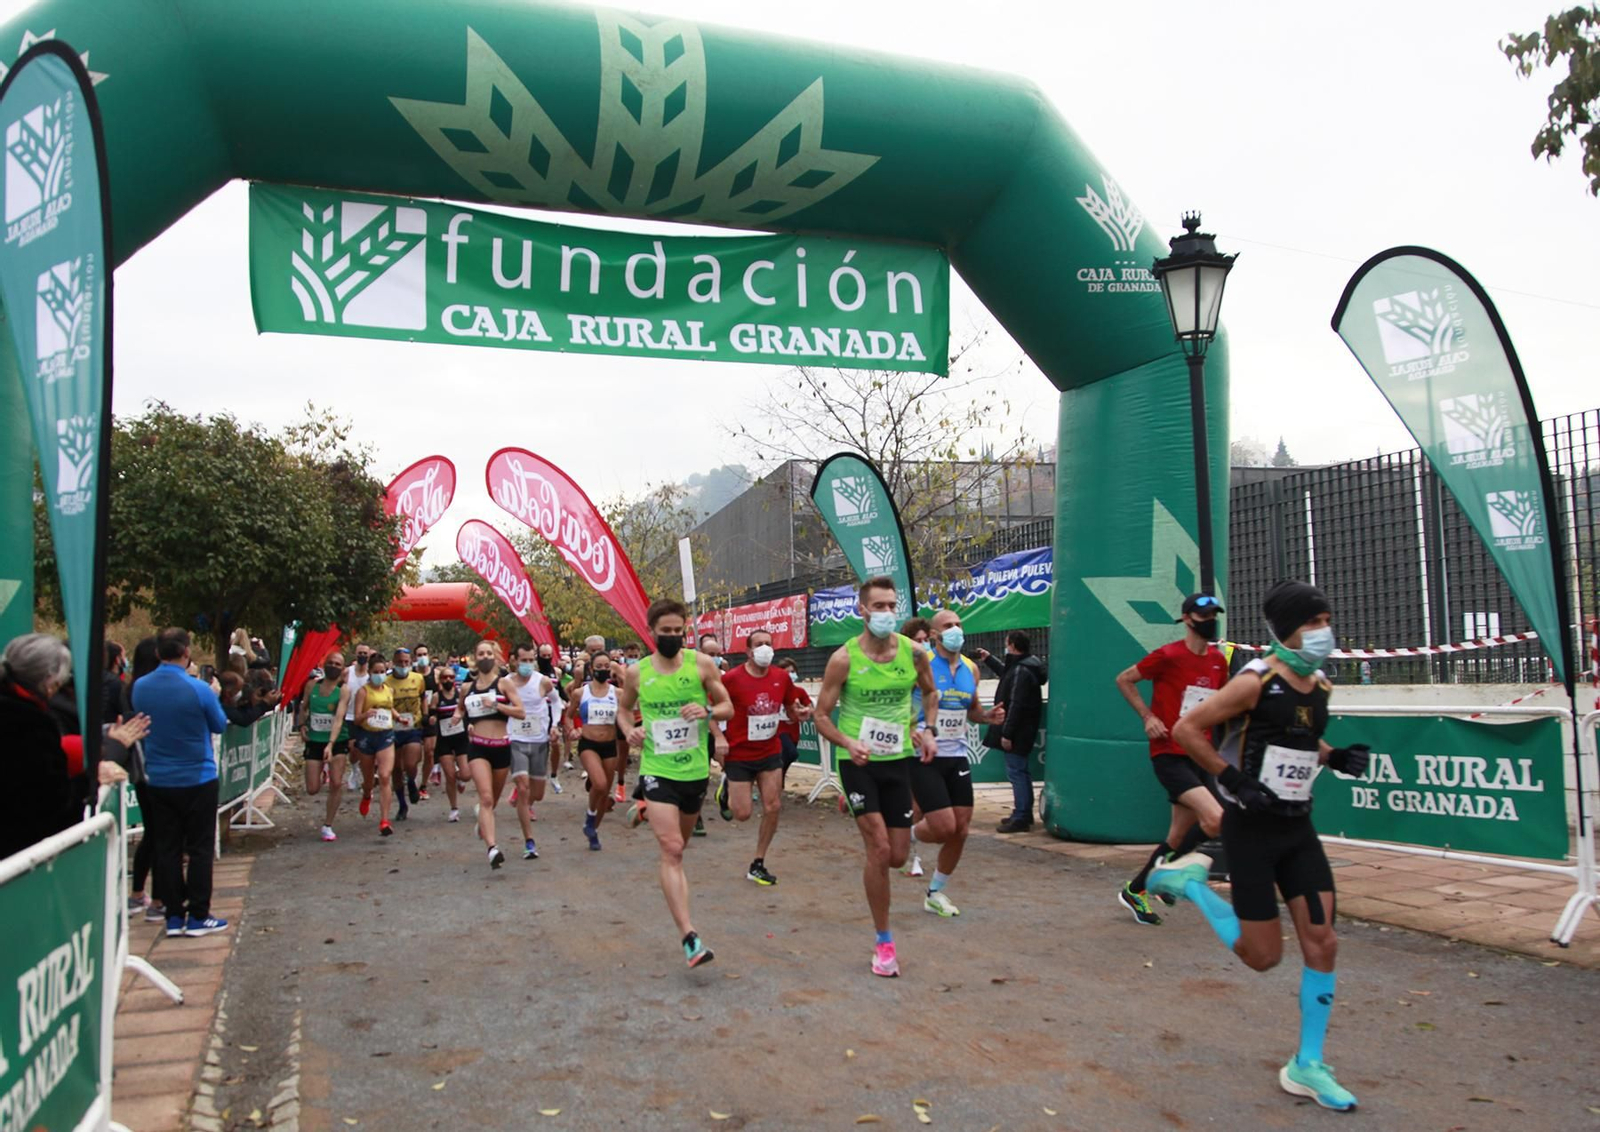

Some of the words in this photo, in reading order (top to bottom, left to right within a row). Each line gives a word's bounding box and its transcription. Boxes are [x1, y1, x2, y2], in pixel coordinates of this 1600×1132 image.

[441, 213, 924, 314] fundación
[1076, 268, 1116, 282] CAJA
[1088, 283, 1105, 293] DE
[1107, 283, 1162, 293] GRANADA
[441, 304, 553, 341] CAJA
[567, 314, 717, 352] RURAL
[729, 323, 926, 361] GRANADA
[987, 568, 1018, 584] PULEVA
[1020, 561, 1053, 579] PULEV
[665, 727, 690, 740] 327
[939, 718, 964, 728] 1024
[869, 730, 900, 745] 1059
[1414, 754, 1545, 792] RURAL
[1351, 786, 1381, 810] DE
[1387, 790, 1519, 821] GRANADA
[17, 921, 95, 1056] RURAL
